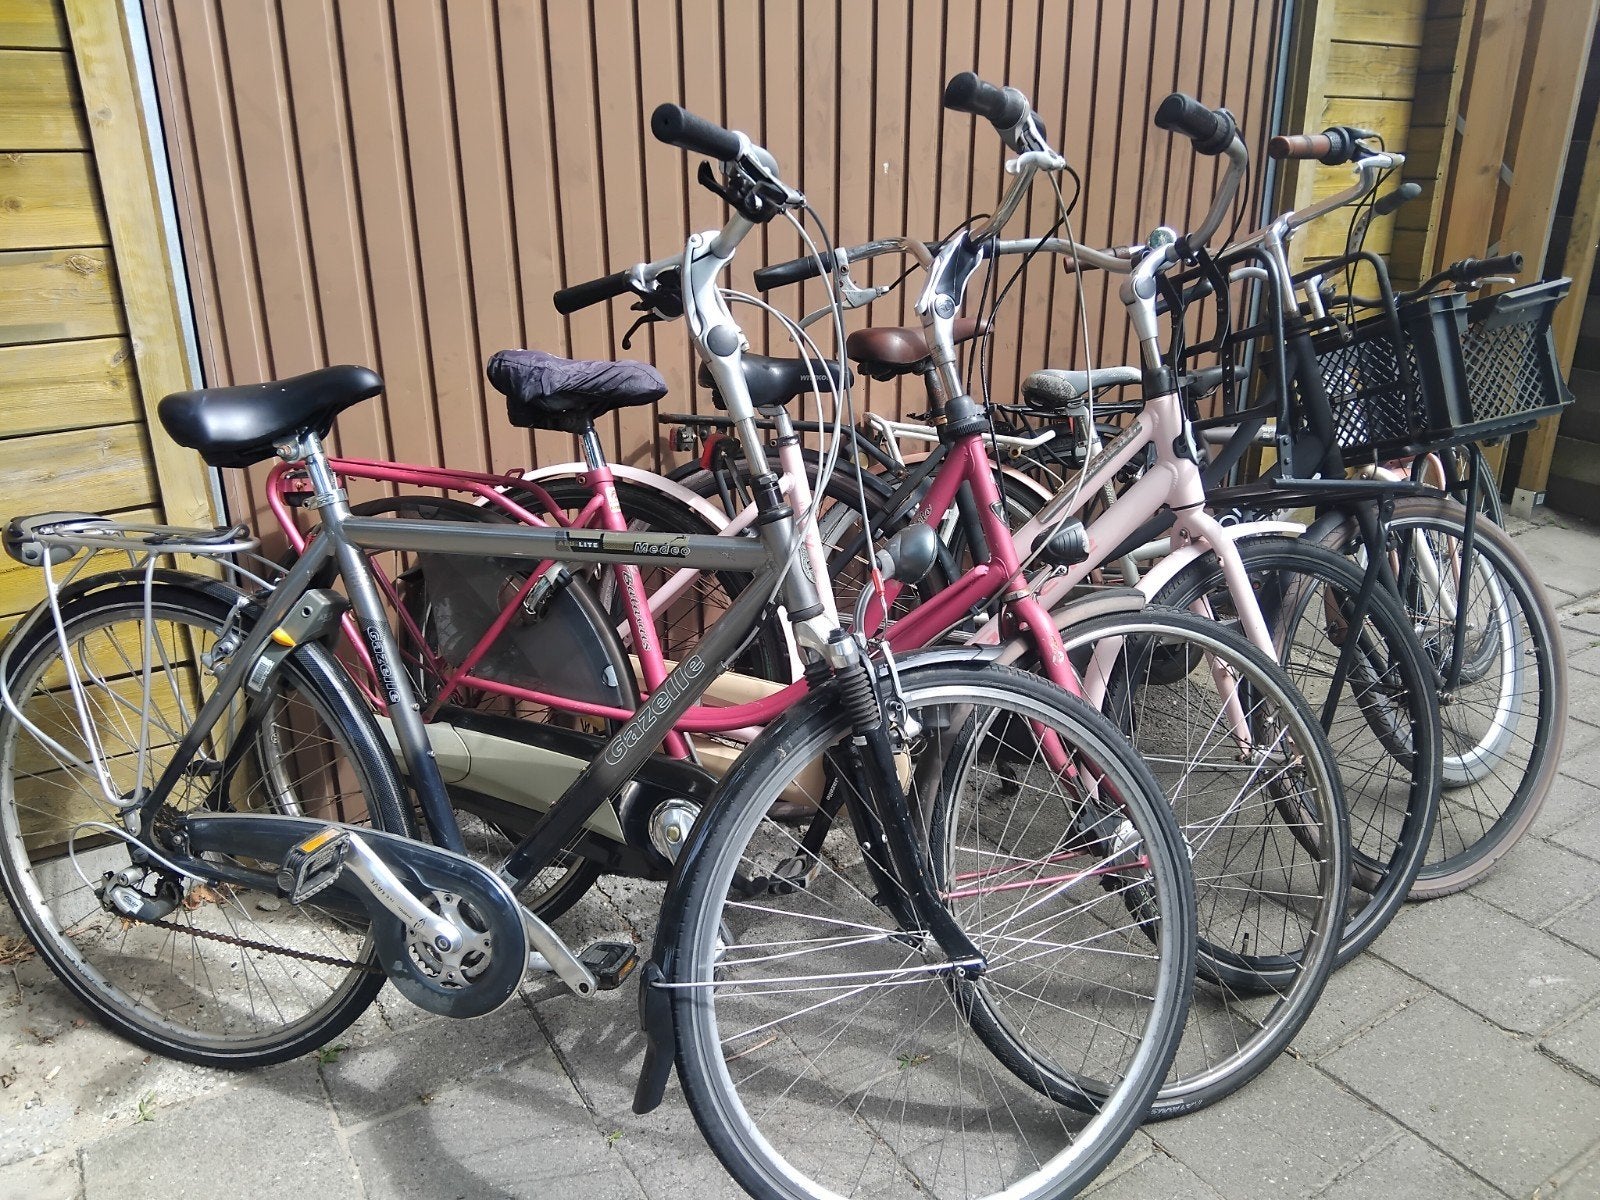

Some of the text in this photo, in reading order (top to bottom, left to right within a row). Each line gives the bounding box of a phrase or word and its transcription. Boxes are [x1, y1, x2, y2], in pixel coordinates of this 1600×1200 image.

[634, 541, 691, 556] Medeo
[622, 570, 650, 651] Batavus
[367, 626, 400, 702] Gazelle
[603, 653, 706, 766] Gazelle
